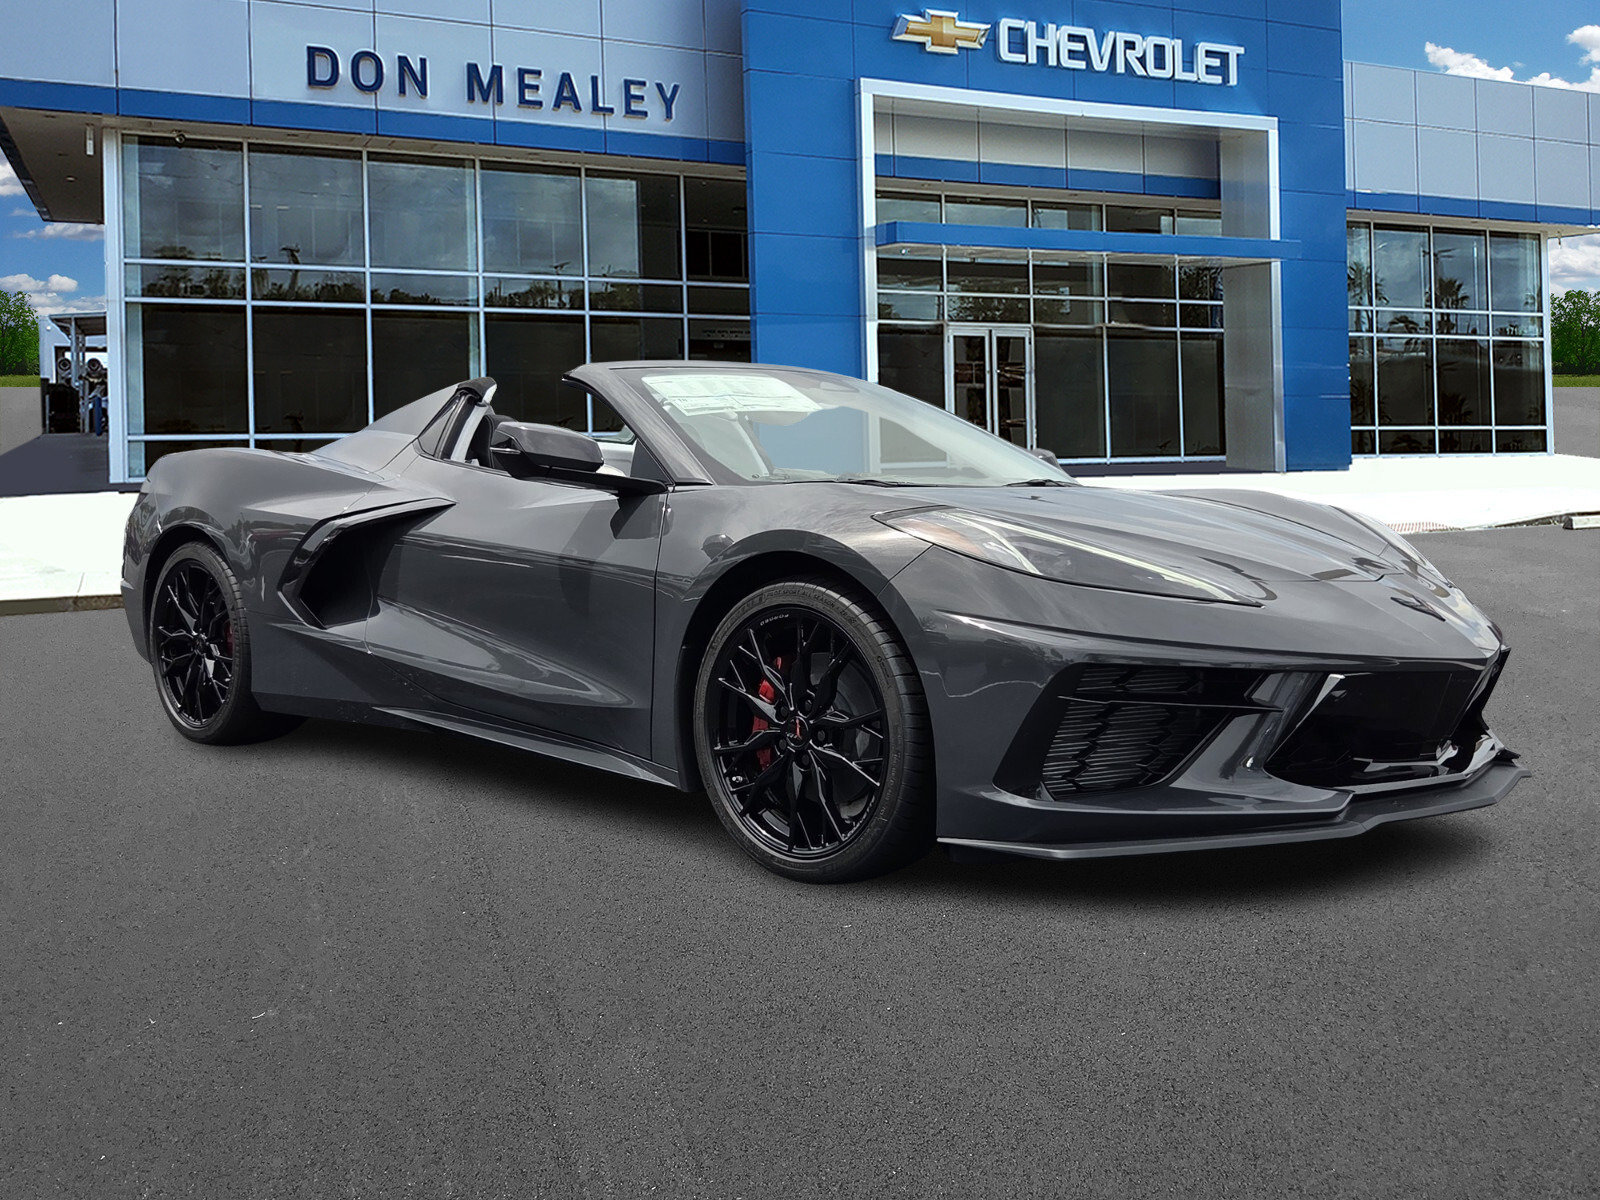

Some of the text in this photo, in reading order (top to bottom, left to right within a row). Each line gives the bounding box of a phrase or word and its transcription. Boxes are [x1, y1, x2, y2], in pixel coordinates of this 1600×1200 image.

[306, 45, 680, 121] DON MEALEY
[998, 18, 1245, 86] CHEVROLET
